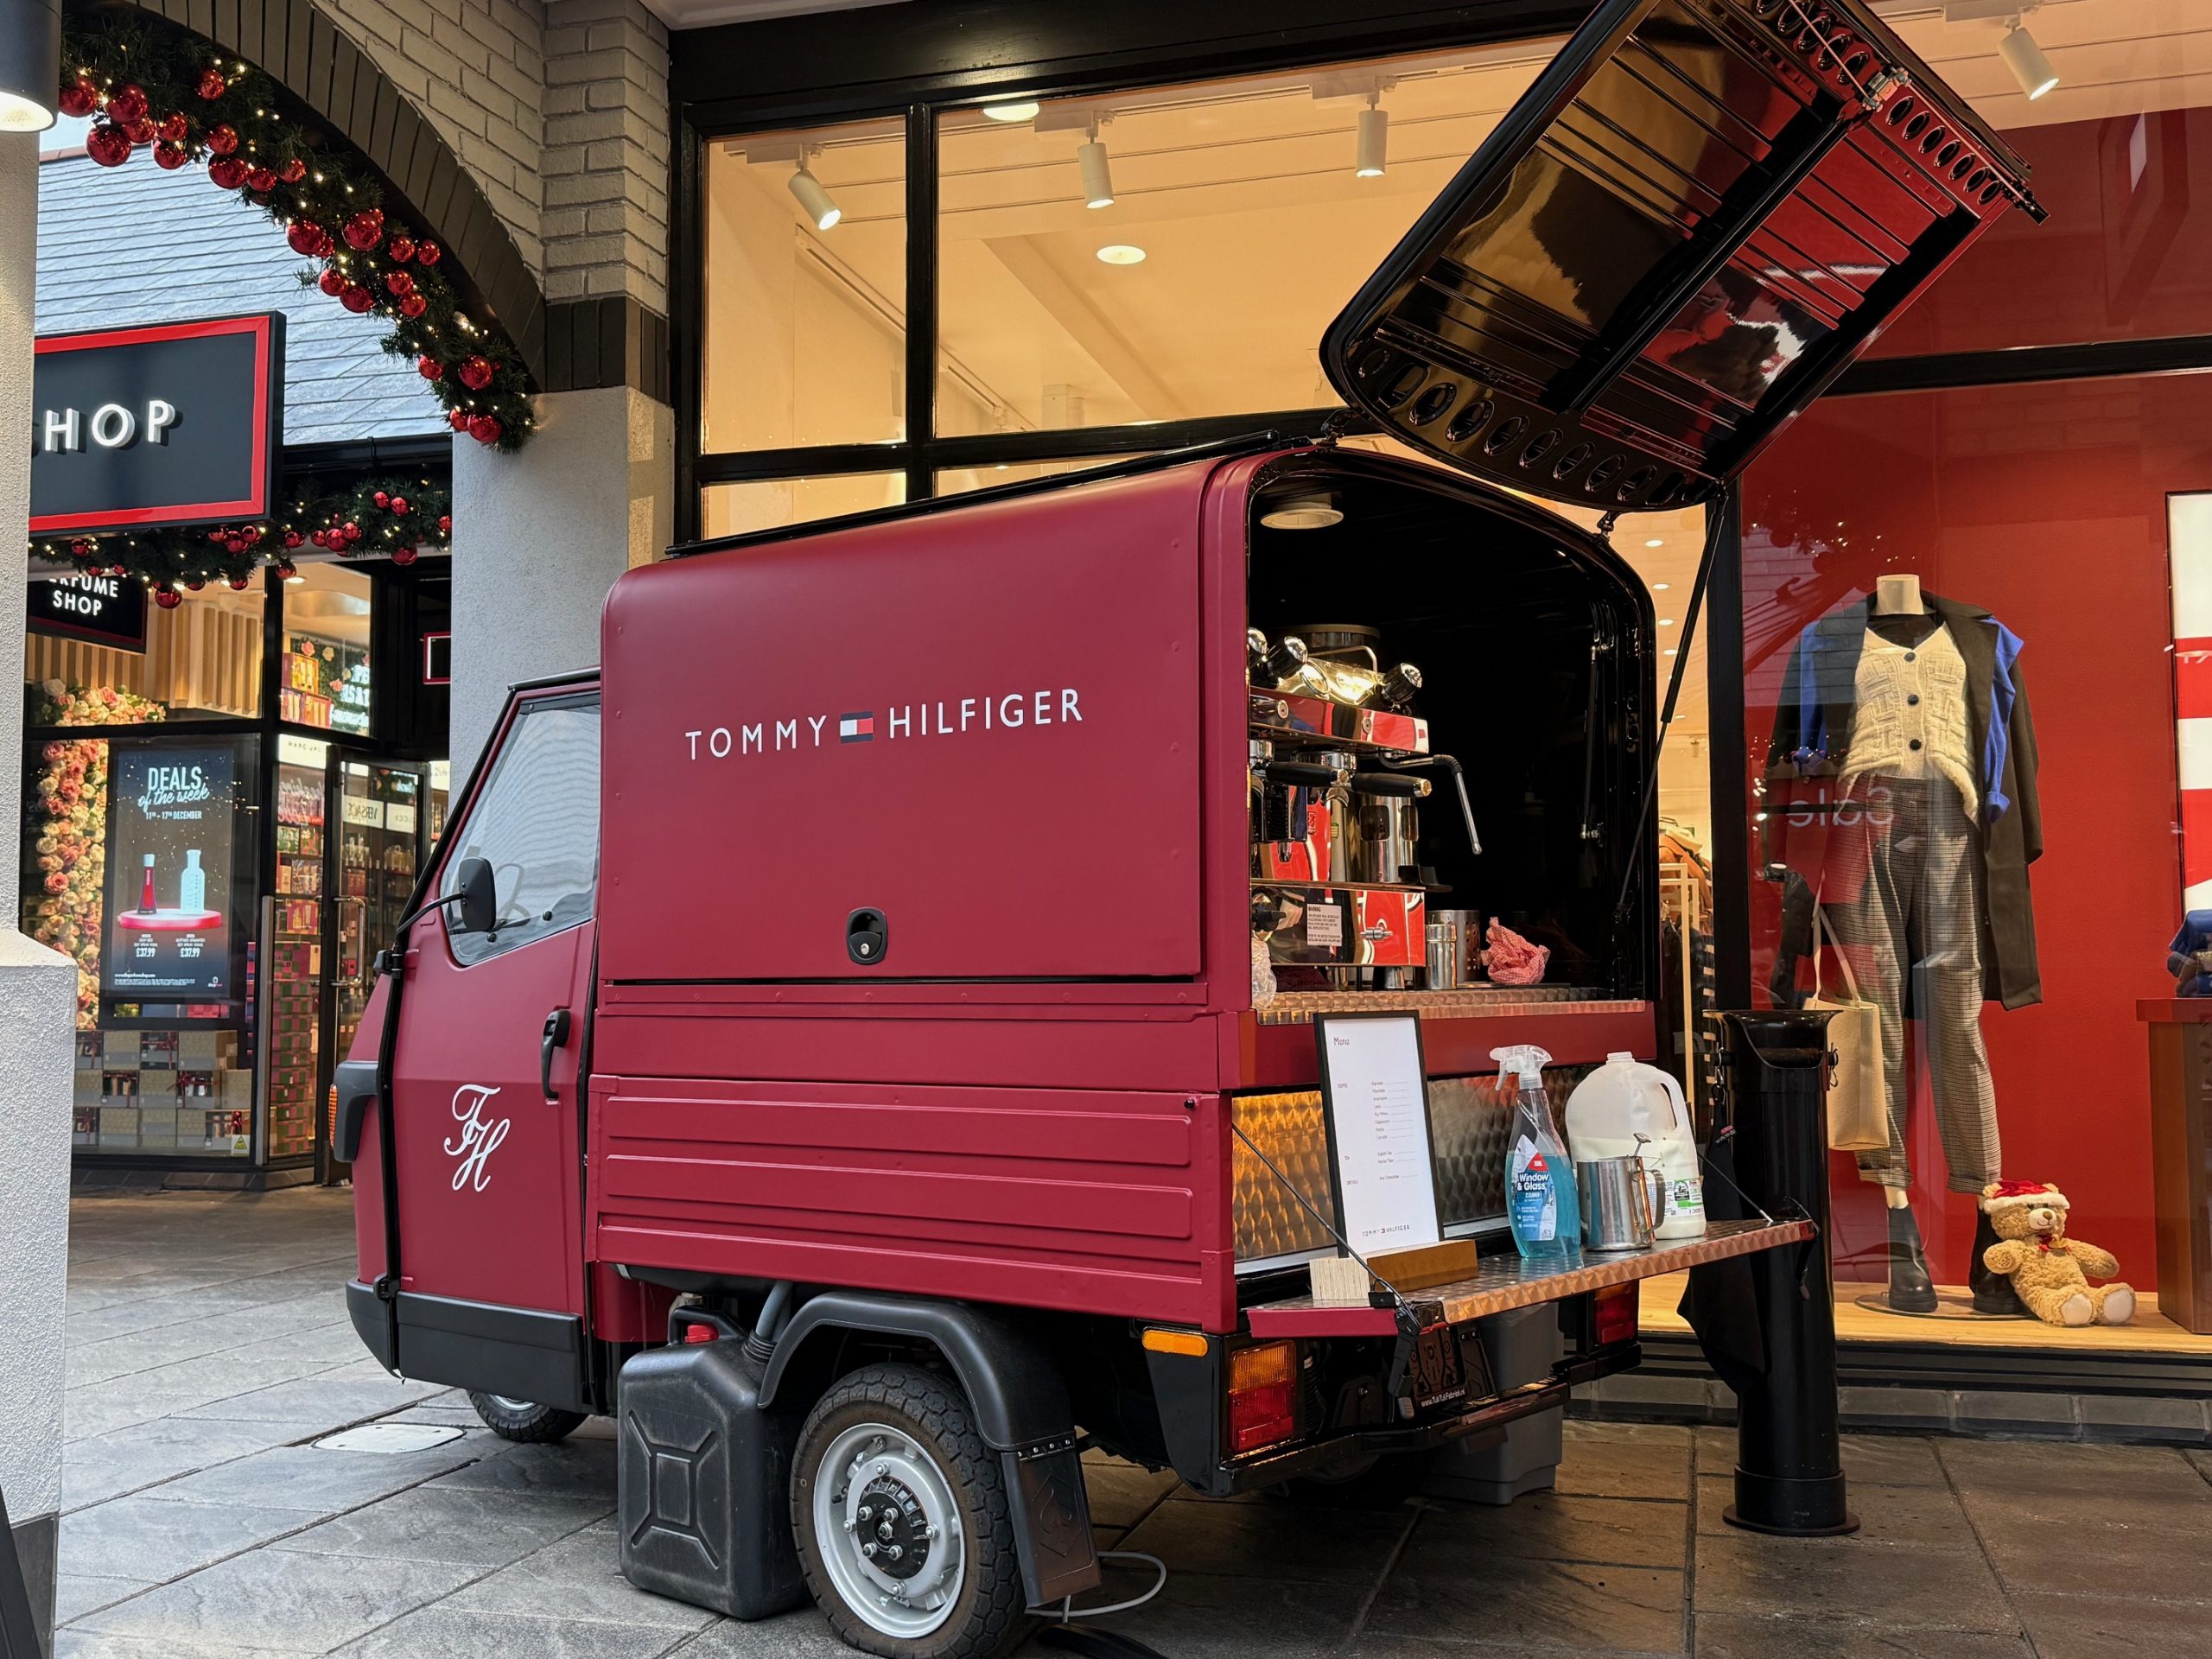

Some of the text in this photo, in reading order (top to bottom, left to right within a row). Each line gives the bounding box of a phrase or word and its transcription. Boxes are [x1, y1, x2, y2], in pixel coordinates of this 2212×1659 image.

[45, 400, 175, 452] HOP
[53, 589, 103, 616] SHOP
[685, 689, 1084, 760] TOMMY HILFIGER
[148, 766, 203, 791] DEALS
[138, 782, 211, 813] of the week
[1516, 1181, 1547, 1192] & Glass
[1519, 1173, 1549, 1182] Window
